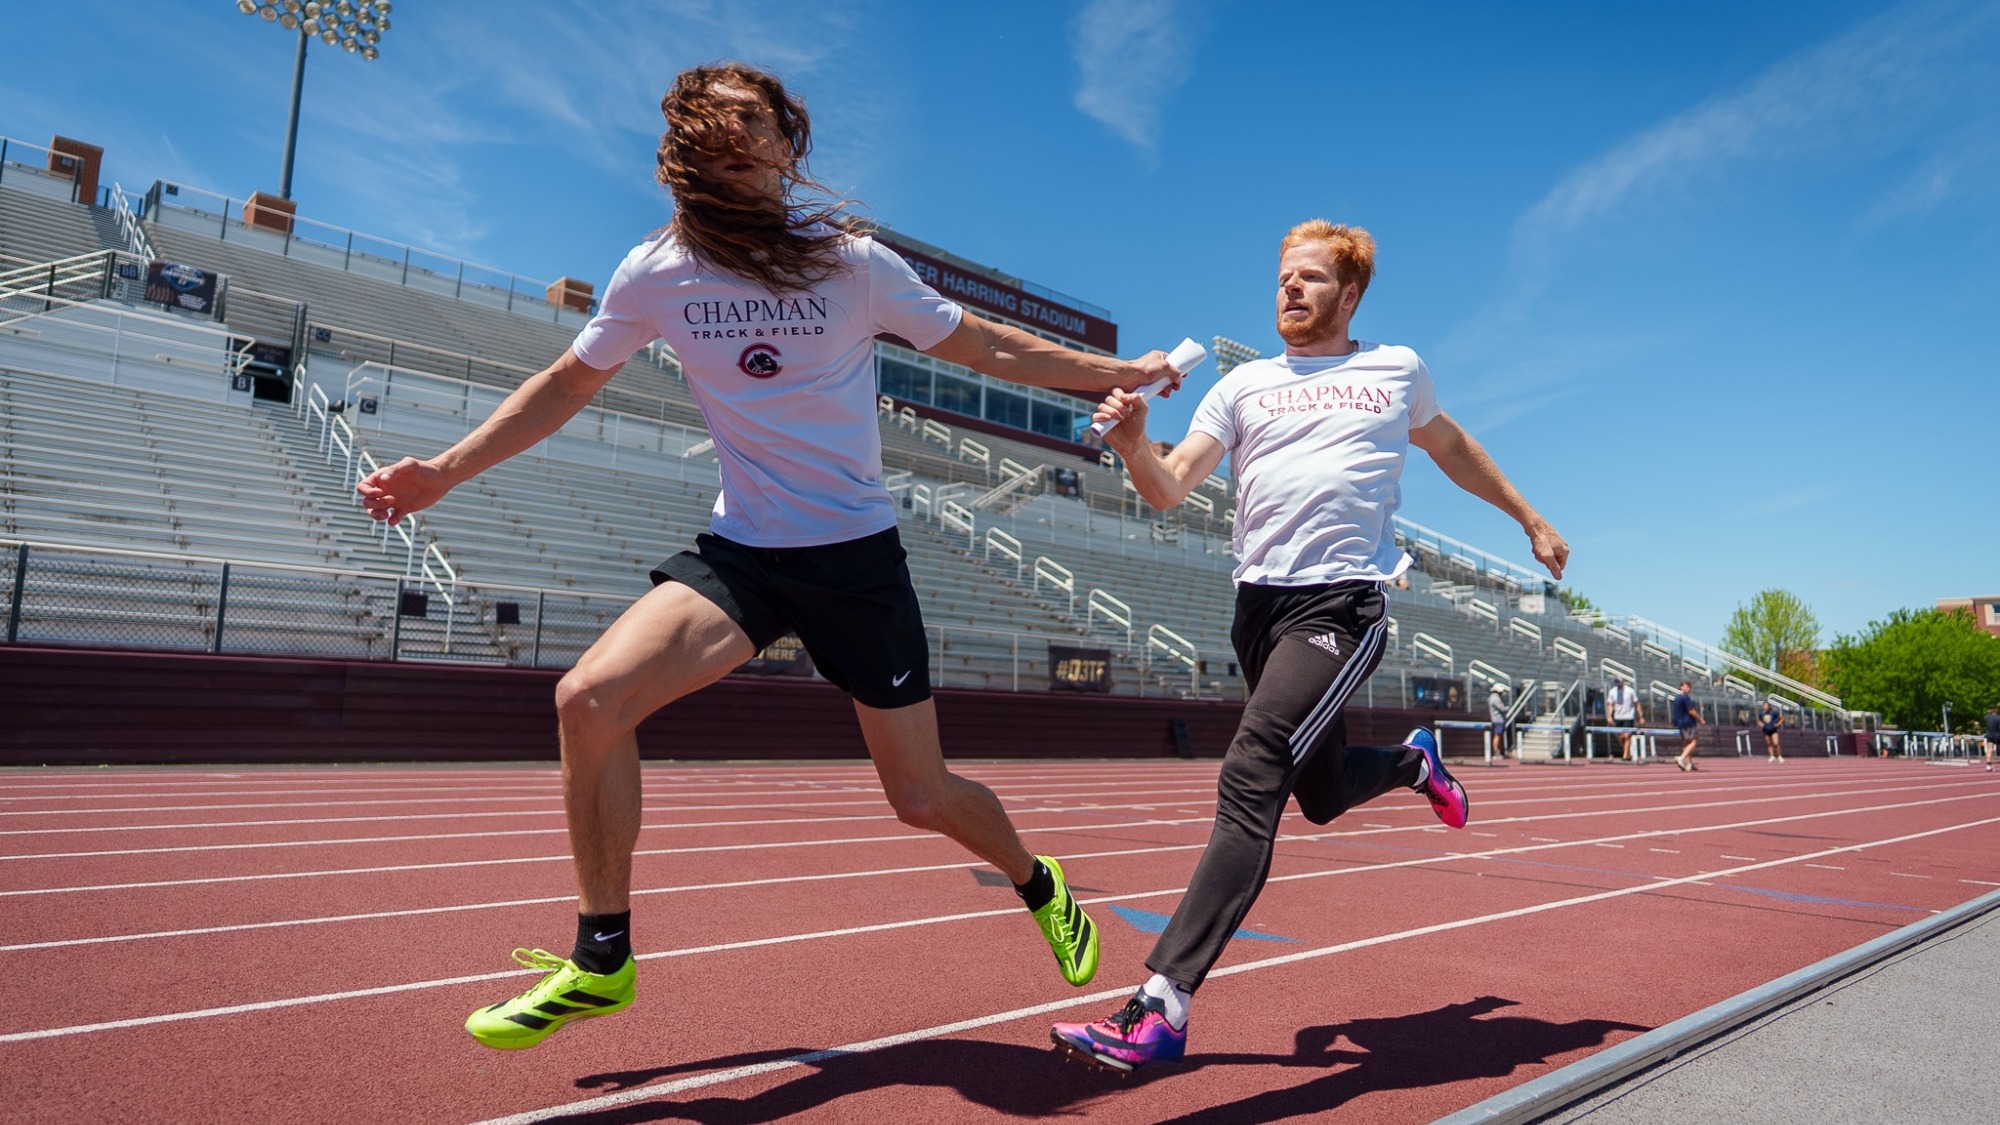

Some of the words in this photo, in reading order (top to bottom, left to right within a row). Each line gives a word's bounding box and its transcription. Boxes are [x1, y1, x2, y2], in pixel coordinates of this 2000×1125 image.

[684, 297, 828, 325] CHAPMAN
[943, 271, 1018, 312] HARRING
[1020, 298, 1086, 336] STADIUM
[691, 328, 749, 340] TRACK
[755, 328, 765, 337] &
[772, 326, 825, 337] FIELD
[237, 377, 247, 389] B
[1259, 385, 1393, 408] CHAPMAN
[363, 400, 375, 411] C
[1268, 404, 1318, 417] TRACK
[1323, 402, 1333, 410] &
[1339, 402, 1382, 414] FIELD
[766, 646, 797, 661] HERE
[1308, 637, 1340, 656] adidas
[1055, 658, 1106, 682] #D3TF
